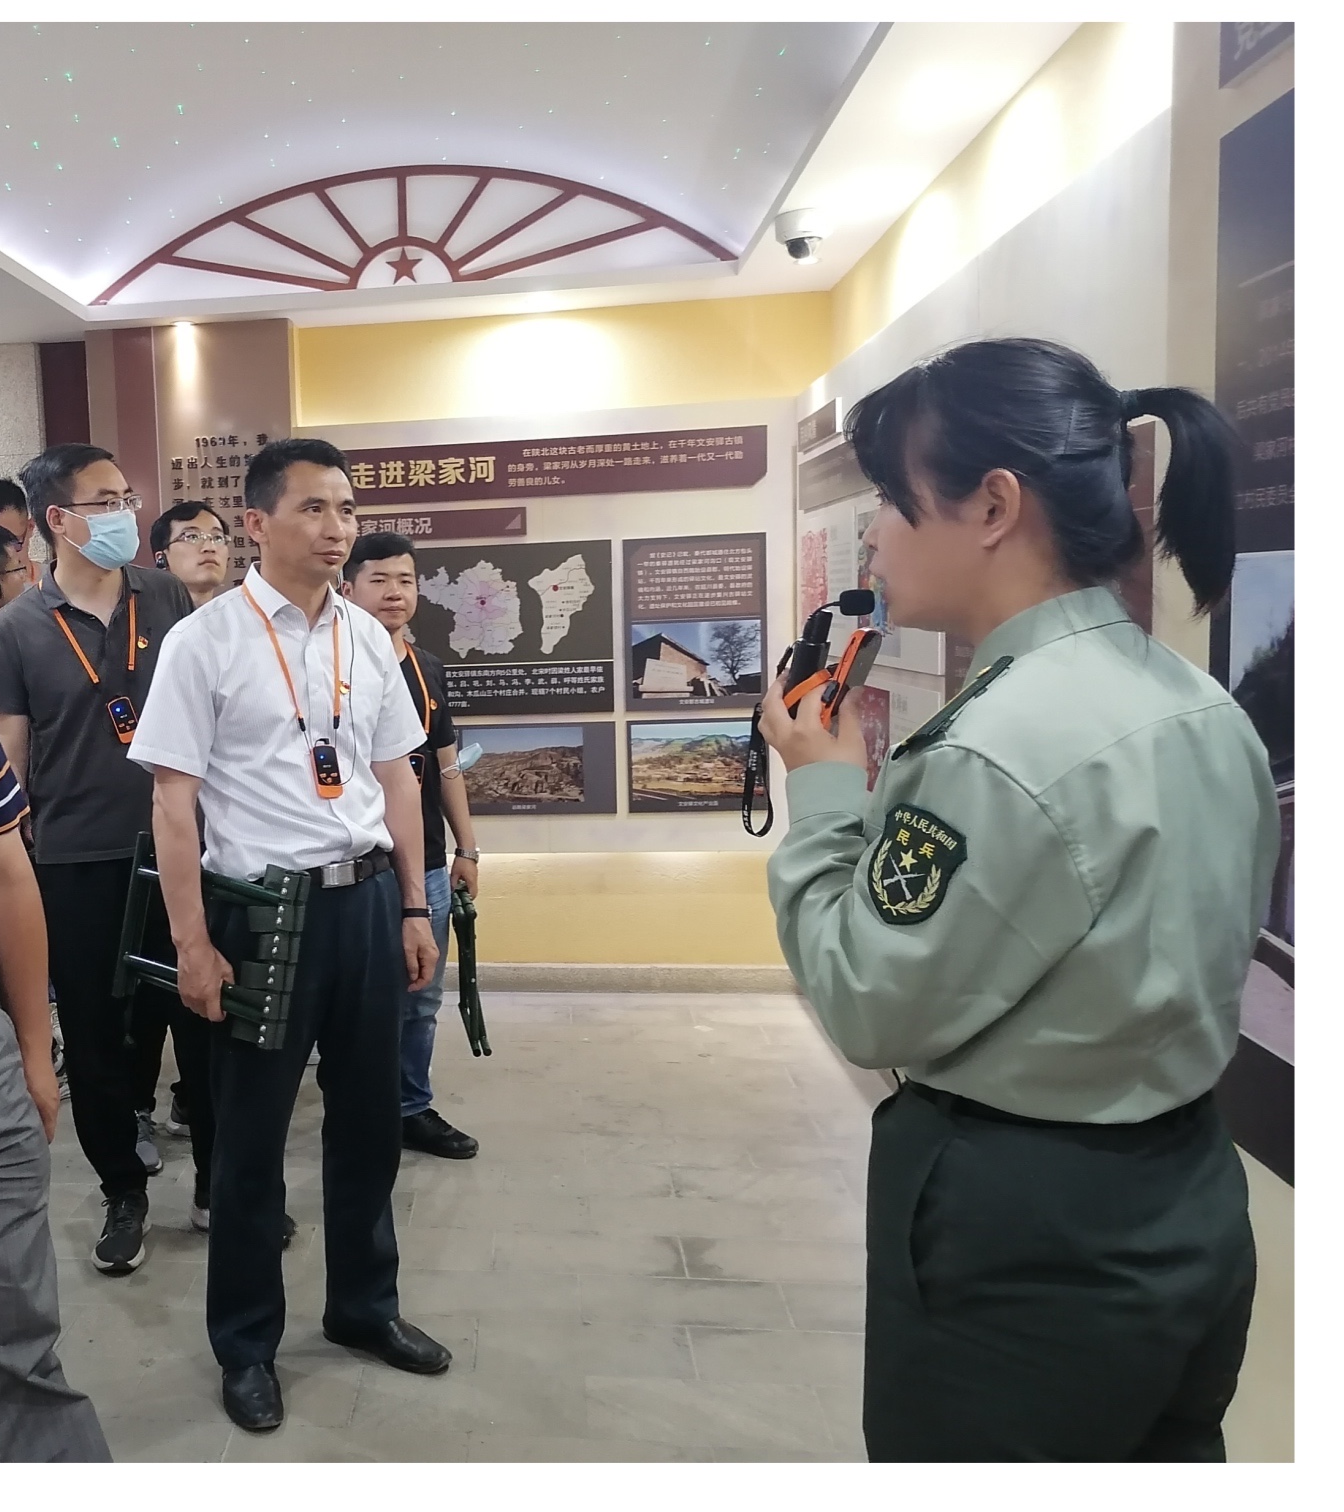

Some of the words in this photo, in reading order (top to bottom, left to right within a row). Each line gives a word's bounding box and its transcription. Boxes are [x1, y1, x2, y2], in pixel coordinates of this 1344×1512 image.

[350, 456, 497, 489] 走进梁家河
[356, 517, 433, 538] 家河概况
[894, 809, 958, 851] 中华人民共和国
[896, 828, 936, 859] 民兵
